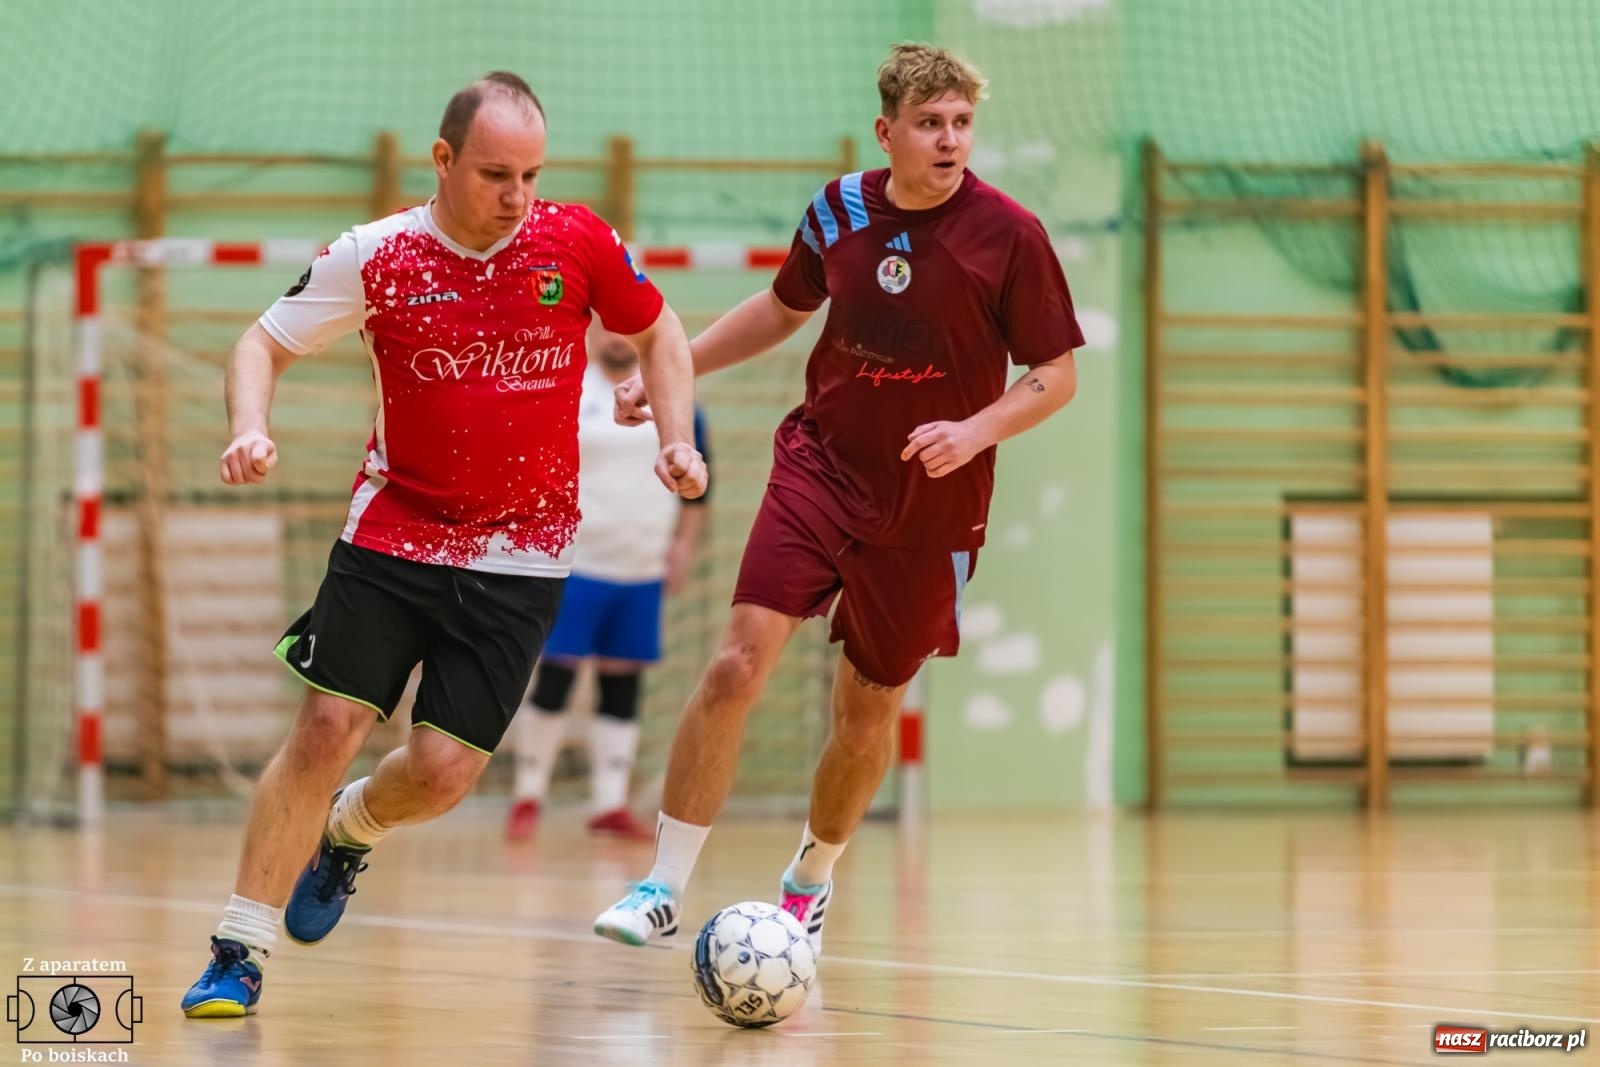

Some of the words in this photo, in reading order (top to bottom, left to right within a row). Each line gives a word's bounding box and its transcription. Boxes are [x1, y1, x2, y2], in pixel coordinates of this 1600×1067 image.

[407, 290, 460, 307] zina
[514, 325, 556, 343] Willa
[410, 339, 575, 381] Wiktoria
[495, 374, 557, 393] Brenna
[856, 361, 947, 387] Lifestyle
